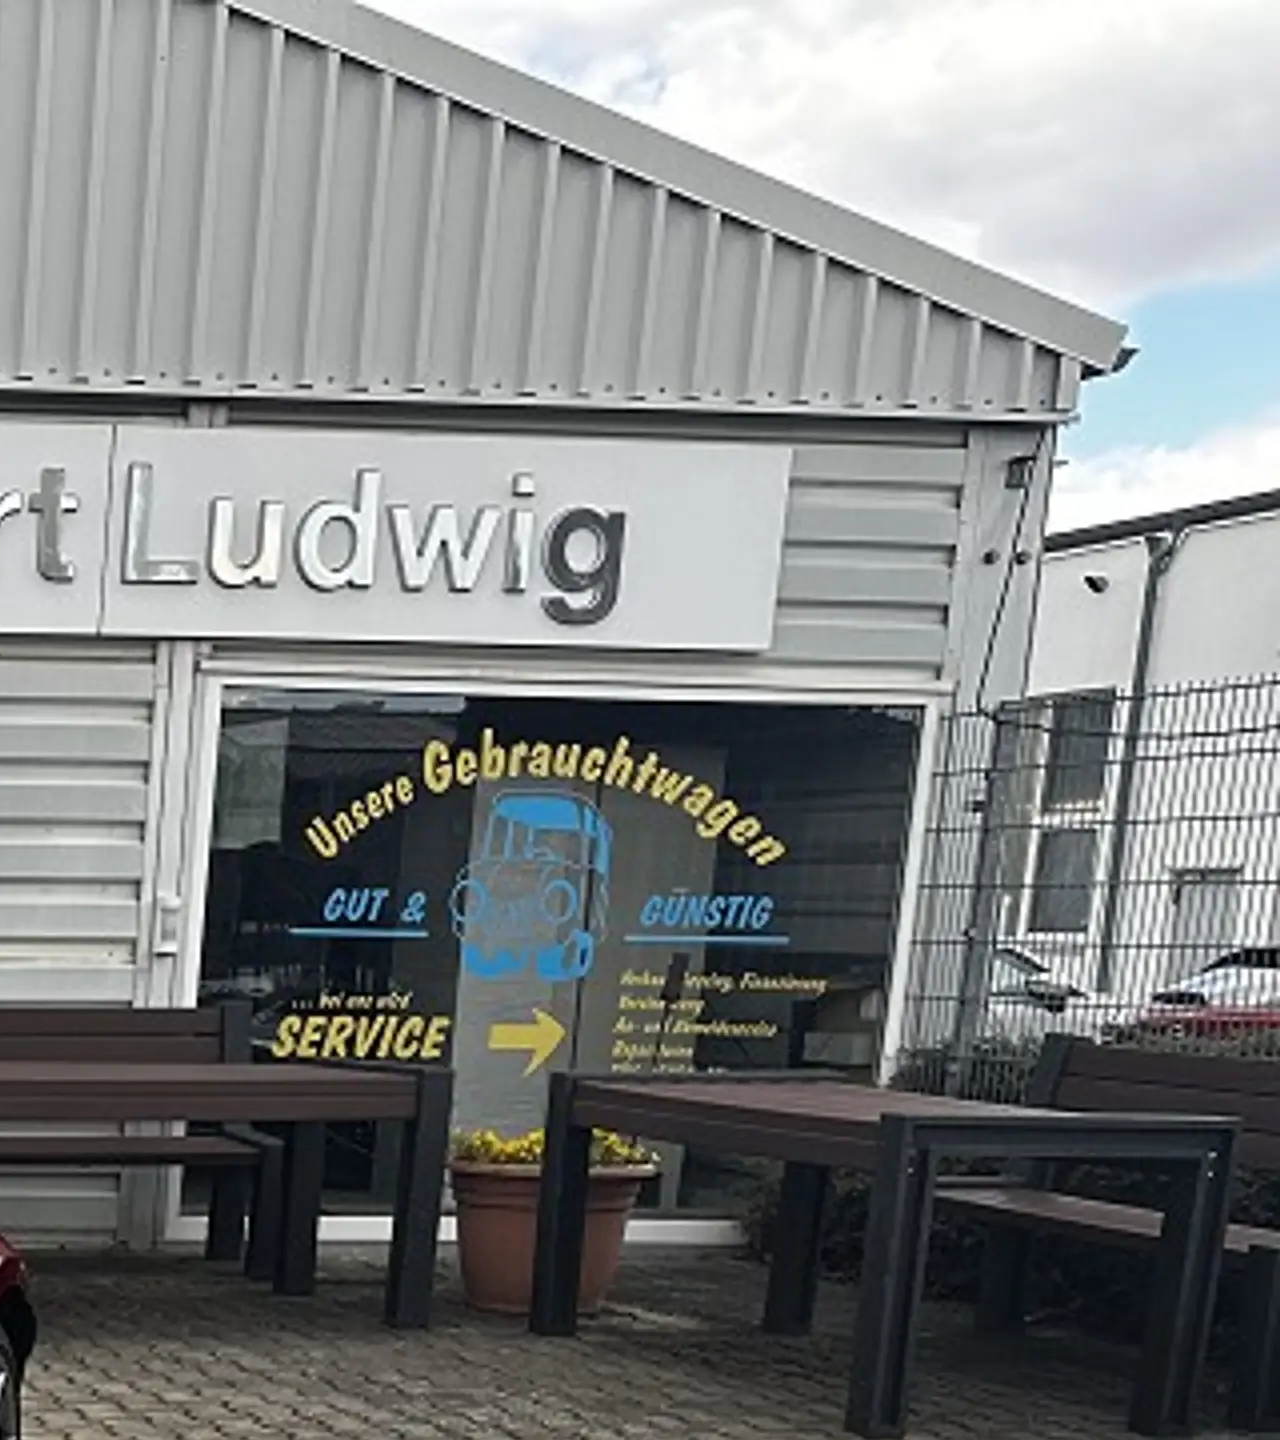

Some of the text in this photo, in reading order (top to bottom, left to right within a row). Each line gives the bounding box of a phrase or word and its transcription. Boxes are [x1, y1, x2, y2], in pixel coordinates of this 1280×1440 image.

[121, 462, 627, 626] Ludwig
[304, 727, 787, 866] Unsere Gebrauchtwagen
[323, 888, 775, 929] GUT & GÜNSTIG
[271, 1014, 452, 1059] SERVICE
